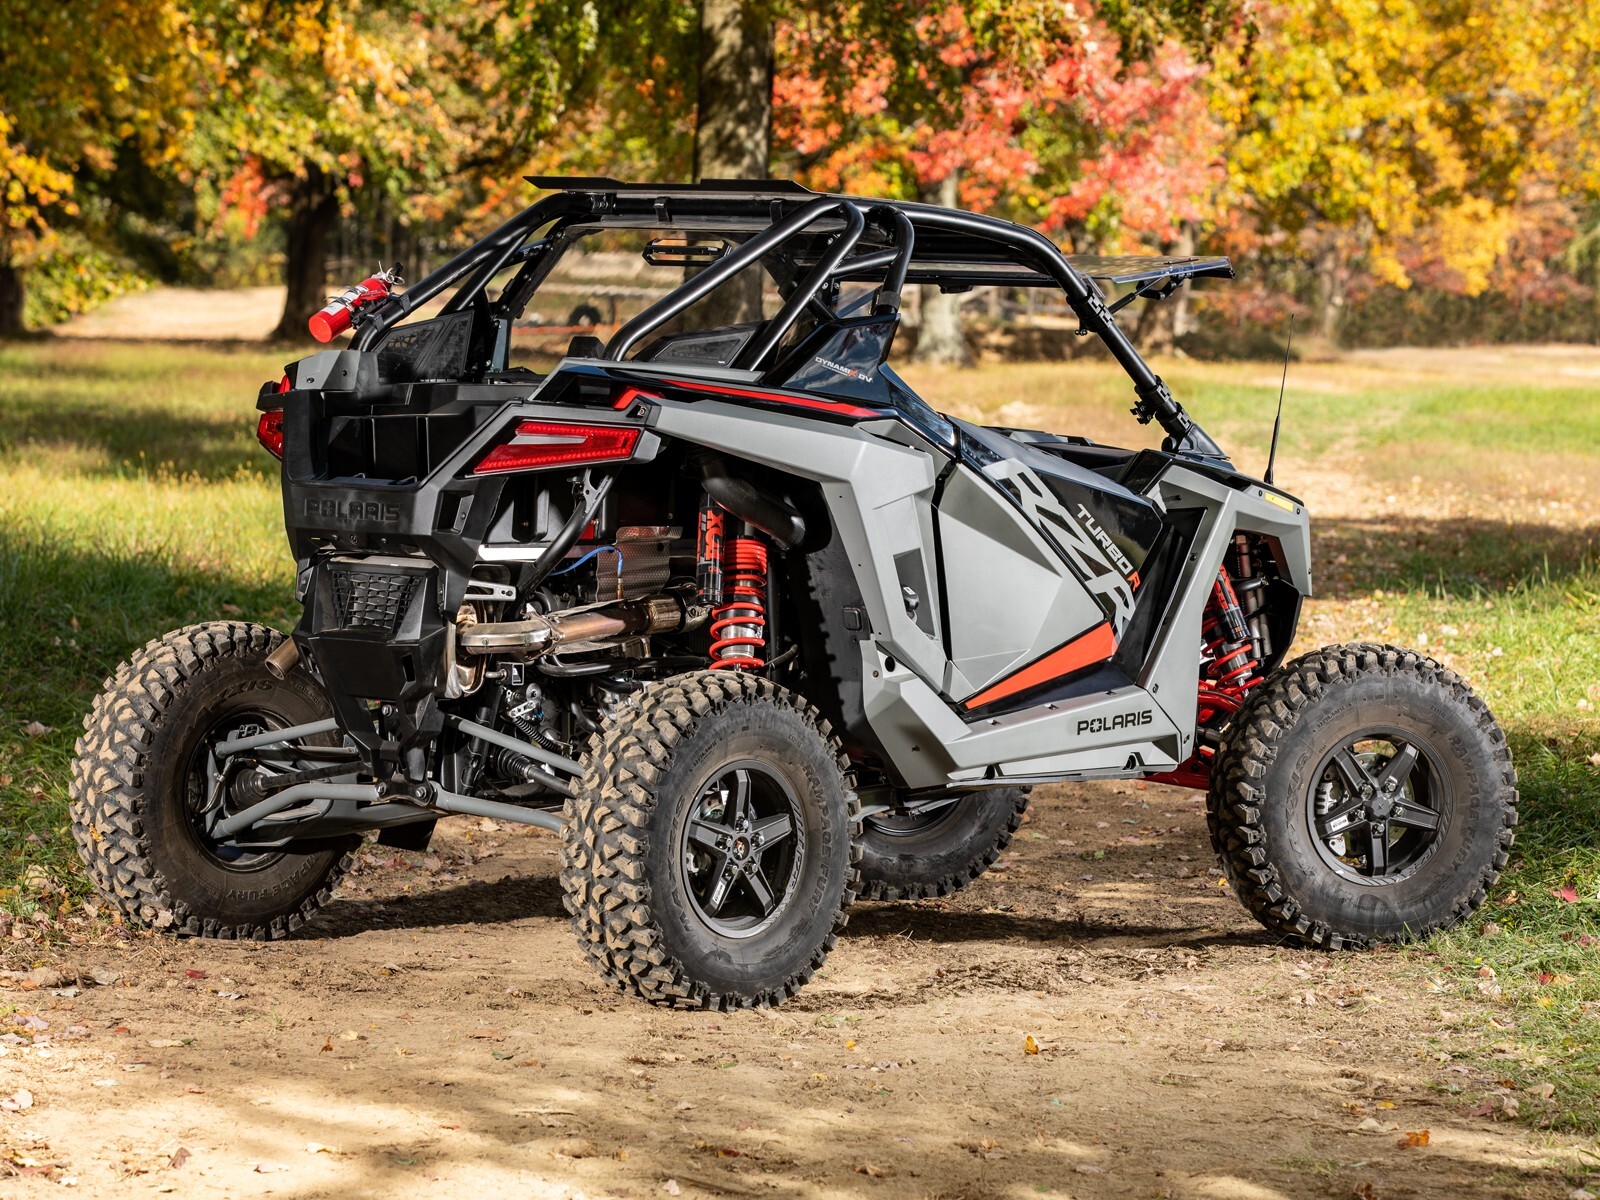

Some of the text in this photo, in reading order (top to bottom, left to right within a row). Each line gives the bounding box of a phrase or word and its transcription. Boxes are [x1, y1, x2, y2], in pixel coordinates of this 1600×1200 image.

[815, 356, 858, 377] DYNAMIX
[304, 497, 401, 523] POLARIS
[981, 457, 1136, 640] RZR
[1077, 709, 1153, 735] POLARIS
[803, 763, 833, 917] RAMPAGE FURY
[667, 794, 693, 932] MAXXIS
[226, 888, 268, 901] FURY
